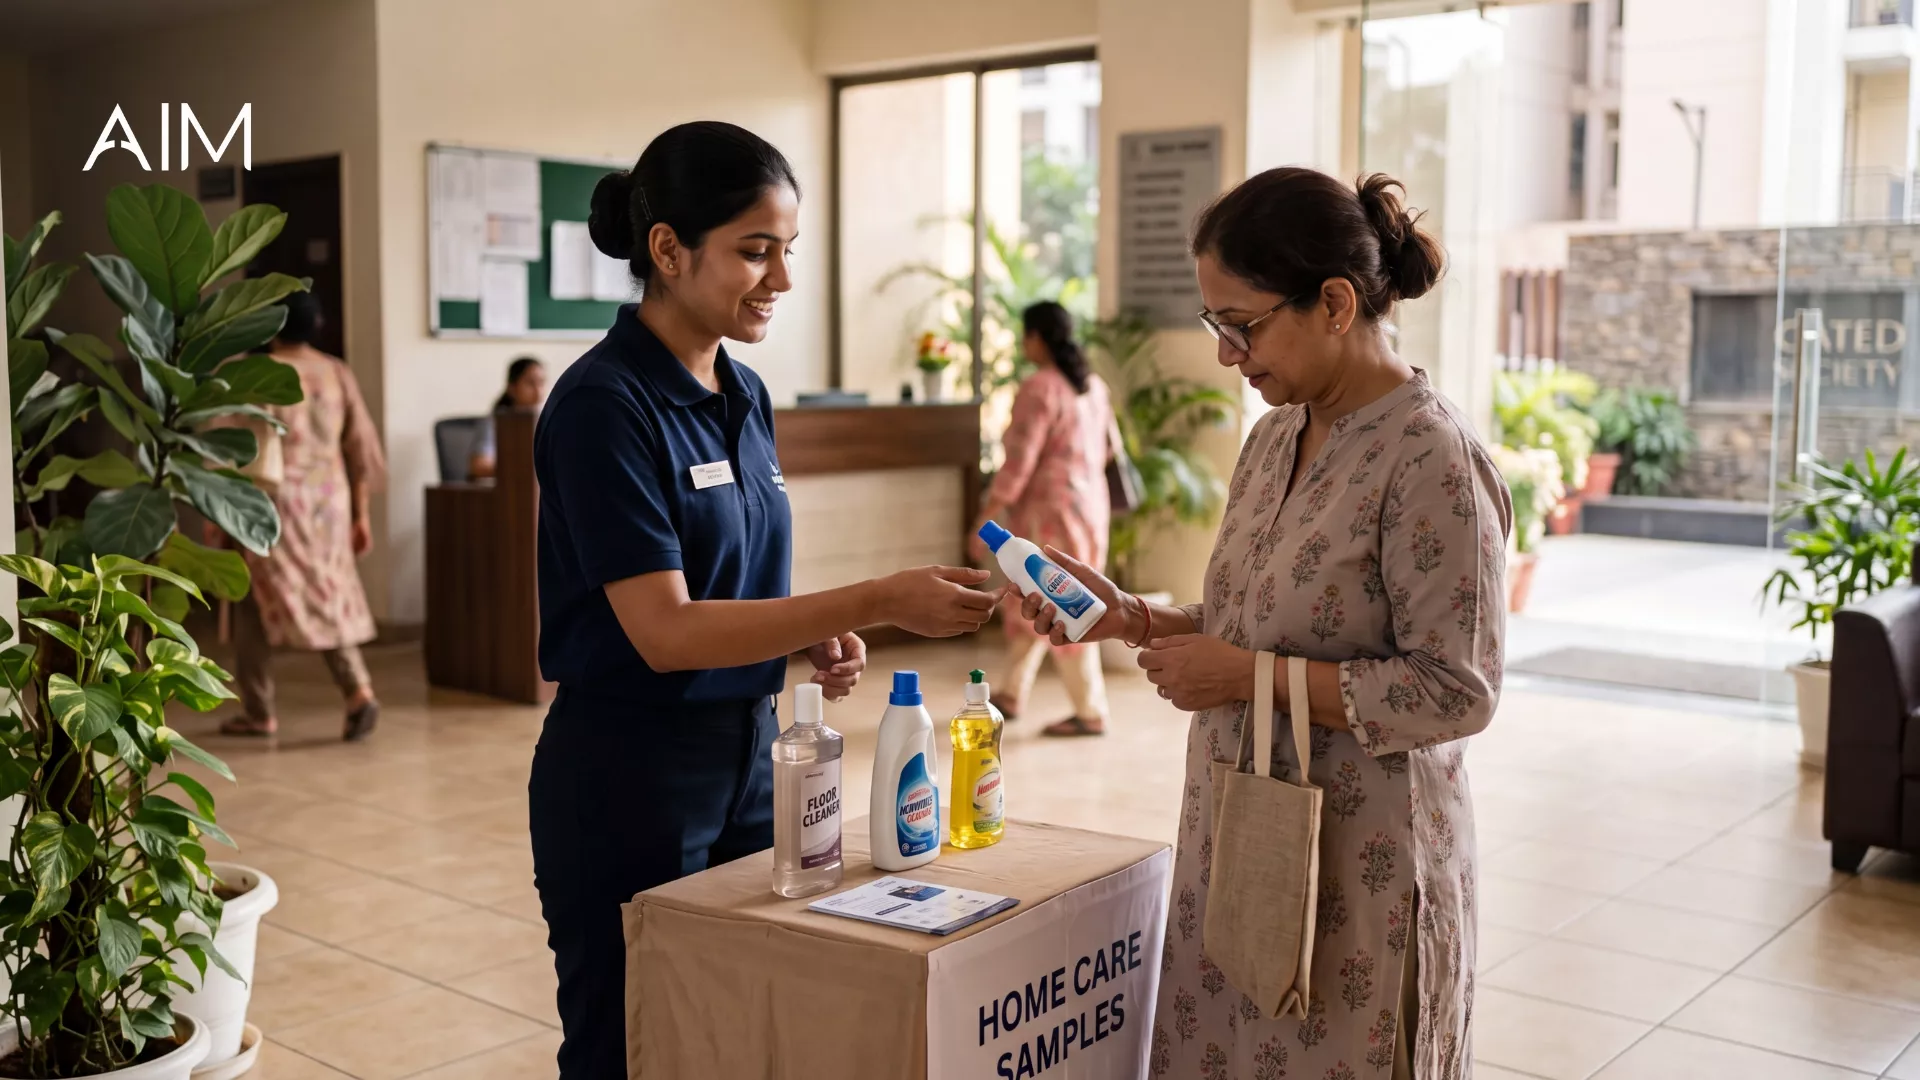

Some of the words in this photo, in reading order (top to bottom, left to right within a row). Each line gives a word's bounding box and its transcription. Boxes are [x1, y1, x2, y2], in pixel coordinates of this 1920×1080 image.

[803, 799, 840, 827] CLEANER
[807, 786, 837, 812] FLOOR
[979, 967, 1066, 1046] HOME
[1073, 930, 1142, 996] CARE
[997, 993, 1125, 1080] SAMPLES
